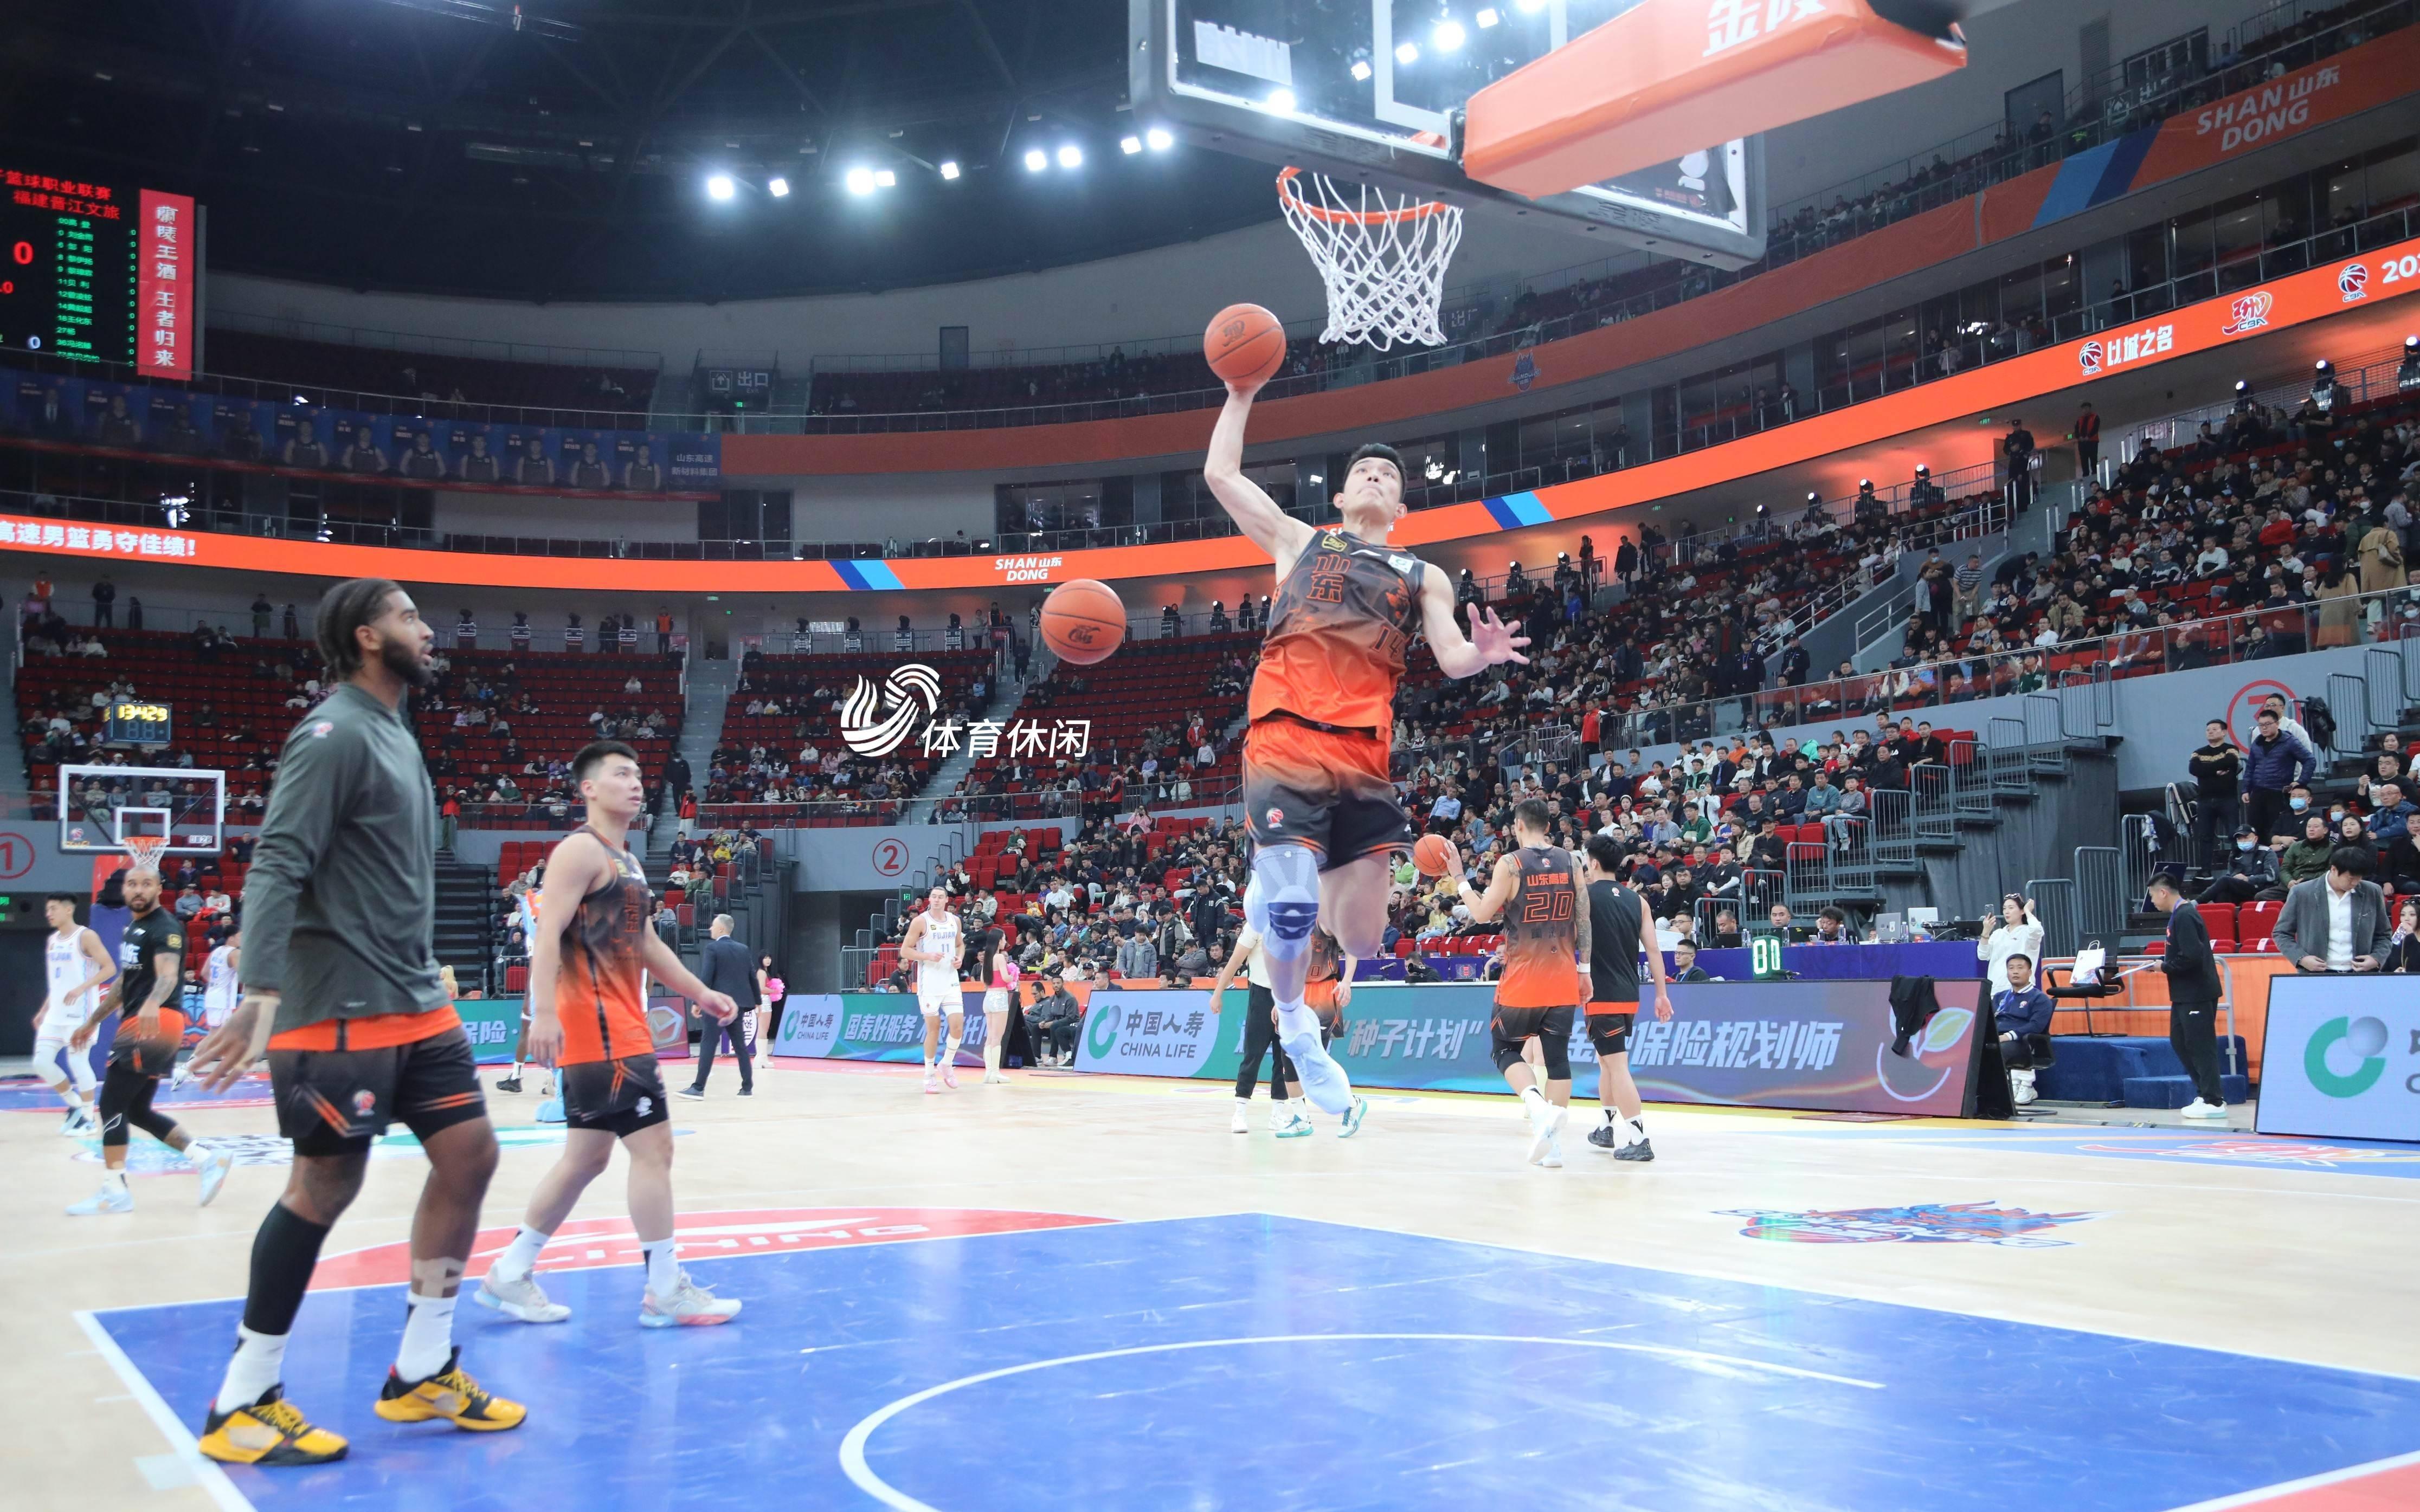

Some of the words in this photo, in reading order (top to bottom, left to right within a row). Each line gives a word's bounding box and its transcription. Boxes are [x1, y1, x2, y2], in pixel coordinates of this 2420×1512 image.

[2197, 85, 2282, 135] SHAN
[2289, 65, 2340, 101] 山东
[2222, 99, 2308, 151] DONG
[0, 169, 112, 201] 篮球职业联赛
[12, 190, 120, 220] 福建晋江文旅
[14, 242, 34, 264] 0
[2342, 292, 2367, 302] CBA
[2382, 253, 2420, 283] 20
[155, 292, 176, 367] 王者归来
[28, 336, 41, 350] 0
[2107, 325, 2172, 366] 以城之名
[738, 371, 768, 387] 出口
[677, 454, 713, 463] 山东高速
[672, 467, 718, 476] 新材料集团
[995, 557, 1037, 570] SHAN
[1039, 557, 1062, 567] 山东
[1006, 568, 1048, 581] DONG
[1306, 554, 1350, 603] 山东
[1527, 873, 1568, 886] 山东高速
[1521, 891, 1574, 923] 20
[941, 944, 950, 953] 11
[801, 1013, 834, 1028] 中国人寿
[844, 1014, 918, 1043] 国寿好服务
[1125, 1009, 1204, 1038] 中国人寿
[797, 1031, 814, 1039] CHINA
[815, 1032, 829, 1040] LIFE
[1567, 1020, 1843, 1070] 金保险规划师
[1121, 1042, 1161, 1057] CHINA
[1166, 1044, 1196, 1058] LIFE
